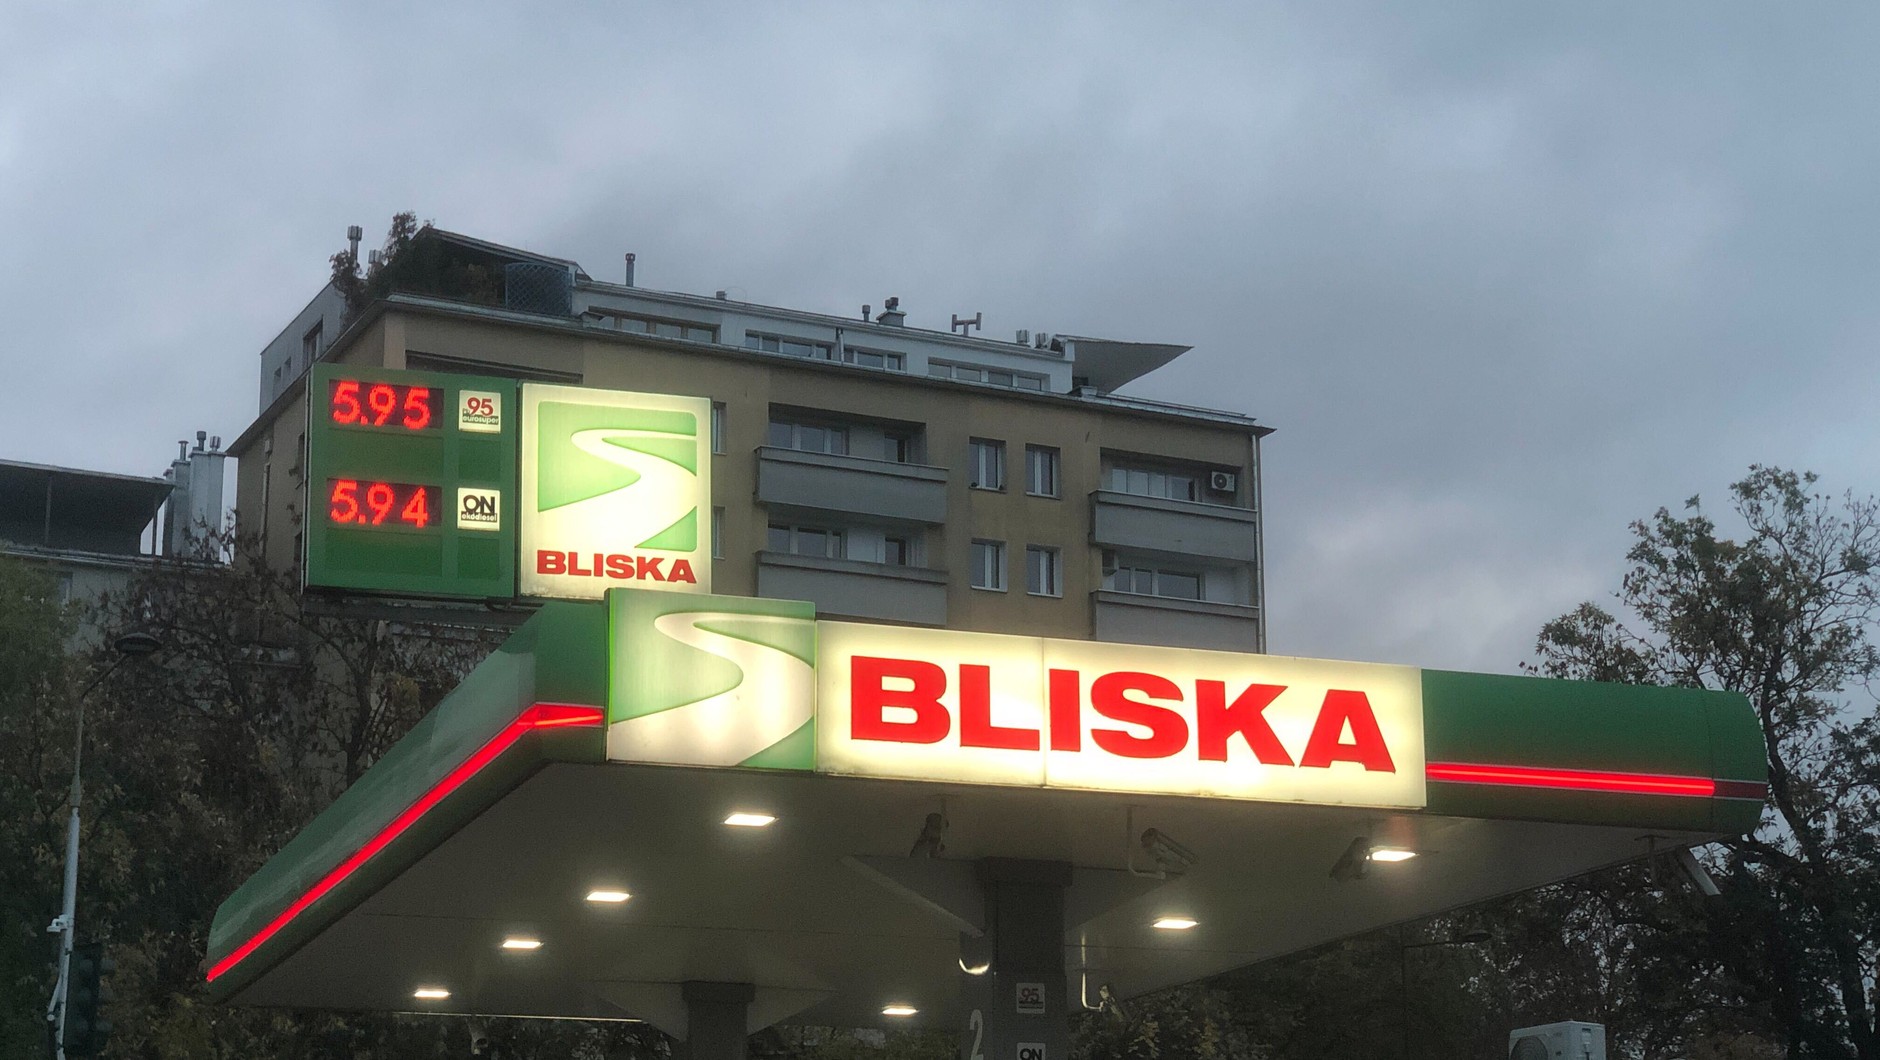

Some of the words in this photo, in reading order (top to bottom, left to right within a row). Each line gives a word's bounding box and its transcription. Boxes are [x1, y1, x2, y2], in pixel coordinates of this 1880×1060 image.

[333, 381, 430, 430] 5.95
[467, 397, 493, 417] 95
[463, 416, 499, 425] eurosuper
[331, 480, 428, 528] 5.94
[463, 495, 495, 514] ON
[537, 549, 697, 584] BLISKA
[851, 655, 1396, 773] BLISKA
[1021, 988, 1039, 1003] 95
[970, 1009, 984, 1060] 2
[1020, 1048, 1042, 1060] ON
